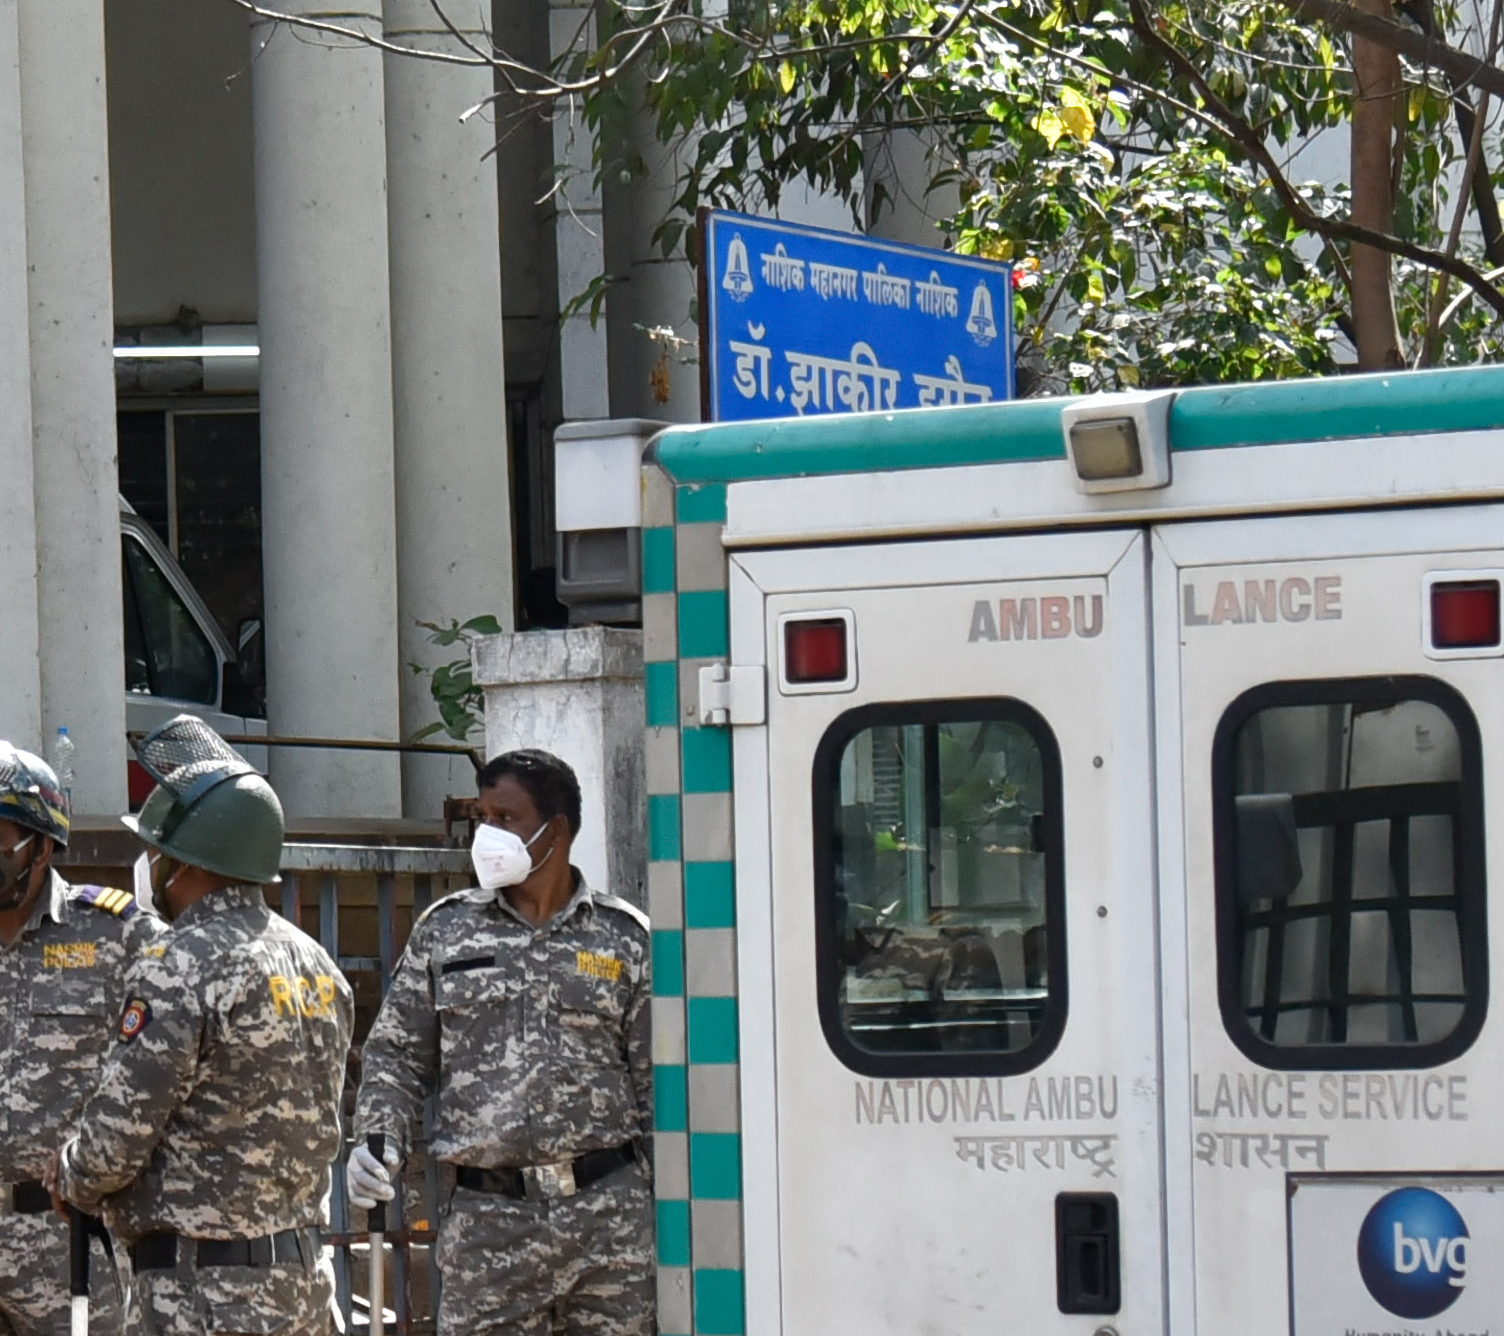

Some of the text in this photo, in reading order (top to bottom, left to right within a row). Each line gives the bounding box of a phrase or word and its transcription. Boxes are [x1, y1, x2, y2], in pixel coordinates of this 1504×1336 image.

[760, 243, 960, 319] नाशिक महानगर पालिका नाशिक
[967, 576, 1343, 644] AMBU LANCE
[854, 1072, 1469, 1124] NATIONAL AMBU LANCE SERVICE
[953, 1131, 1330, 1178] महाराष्ट्र शासन
[1394, 1221, 1471, 1287] bvg
